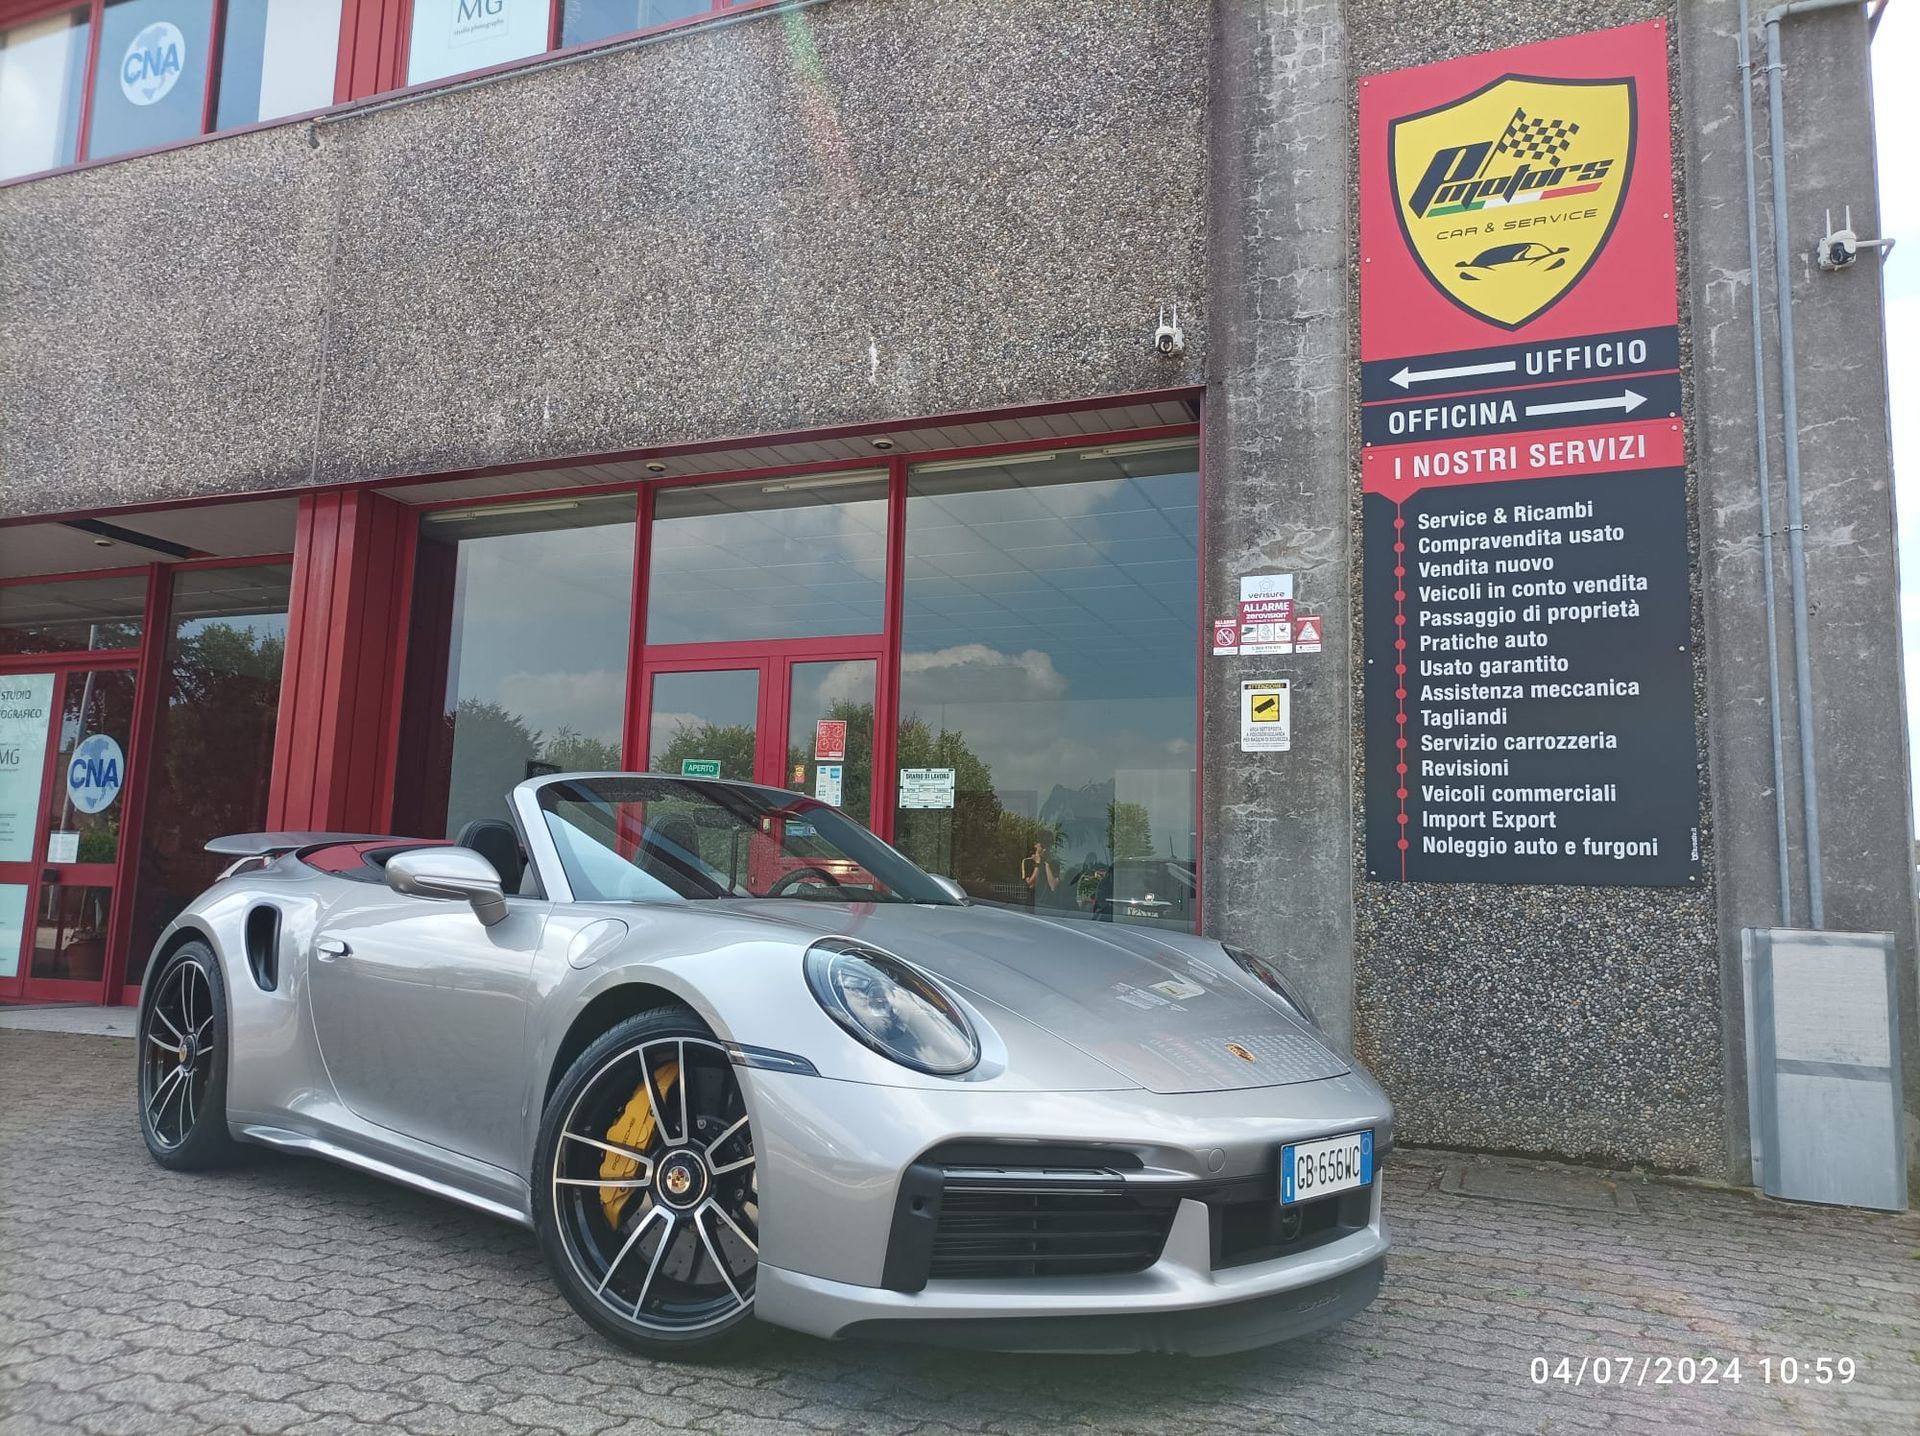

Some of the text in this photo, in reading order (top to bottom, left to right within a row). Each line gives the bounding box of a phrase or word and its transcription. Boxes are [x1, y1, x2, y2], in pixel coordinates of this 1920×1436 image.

[457, 0, 503, 23] MG
[123, 43, 180, 85] CNA
[1436, 208, 1598, 240] CAR & SERVICE
[1525, 339, 1648, 375] UFFICIO
[1388, 400, 1518, 435] OFFICINA
[1394, 434, 1646, 480] I NOSTRI SERVIZI
[1418, 500, 1593, 530] Service & Ricambi
[1418, 525, 1624, 554] Compravendita usato
[1418, 557, 1554, 578] Vendita nuovo
[1418, 574, 1648, 602] Veicoli in conto vendita
[1243, 602, 1290, 613] ALLARME
[1419, 599, 1640, 628] Passaggio di proprietà
[1420, 631, 1548, 652] Pratiche auto
[1420, 654, 1569, 677] Usato garantito
[1, 690, 32, 700] STUDIO
[1420, 680, 1640, 702] Assistenza meccanica
[1420, 708, 1507, 730] Tagliandi
[1421, 732, 1617, 752] Servizio carrozzeria
[69, 758, 119, 789] CNA
[688, 764, 715, 773] APERTO
[1421, 759, 1509, 776] Revisioni
[1421, 784, 1616, 802] Veicoli commerciali
[1422, 811, 1557, 832] Import Export
[1423, 837, 1658, 860] Noleggio auto e furgoni
